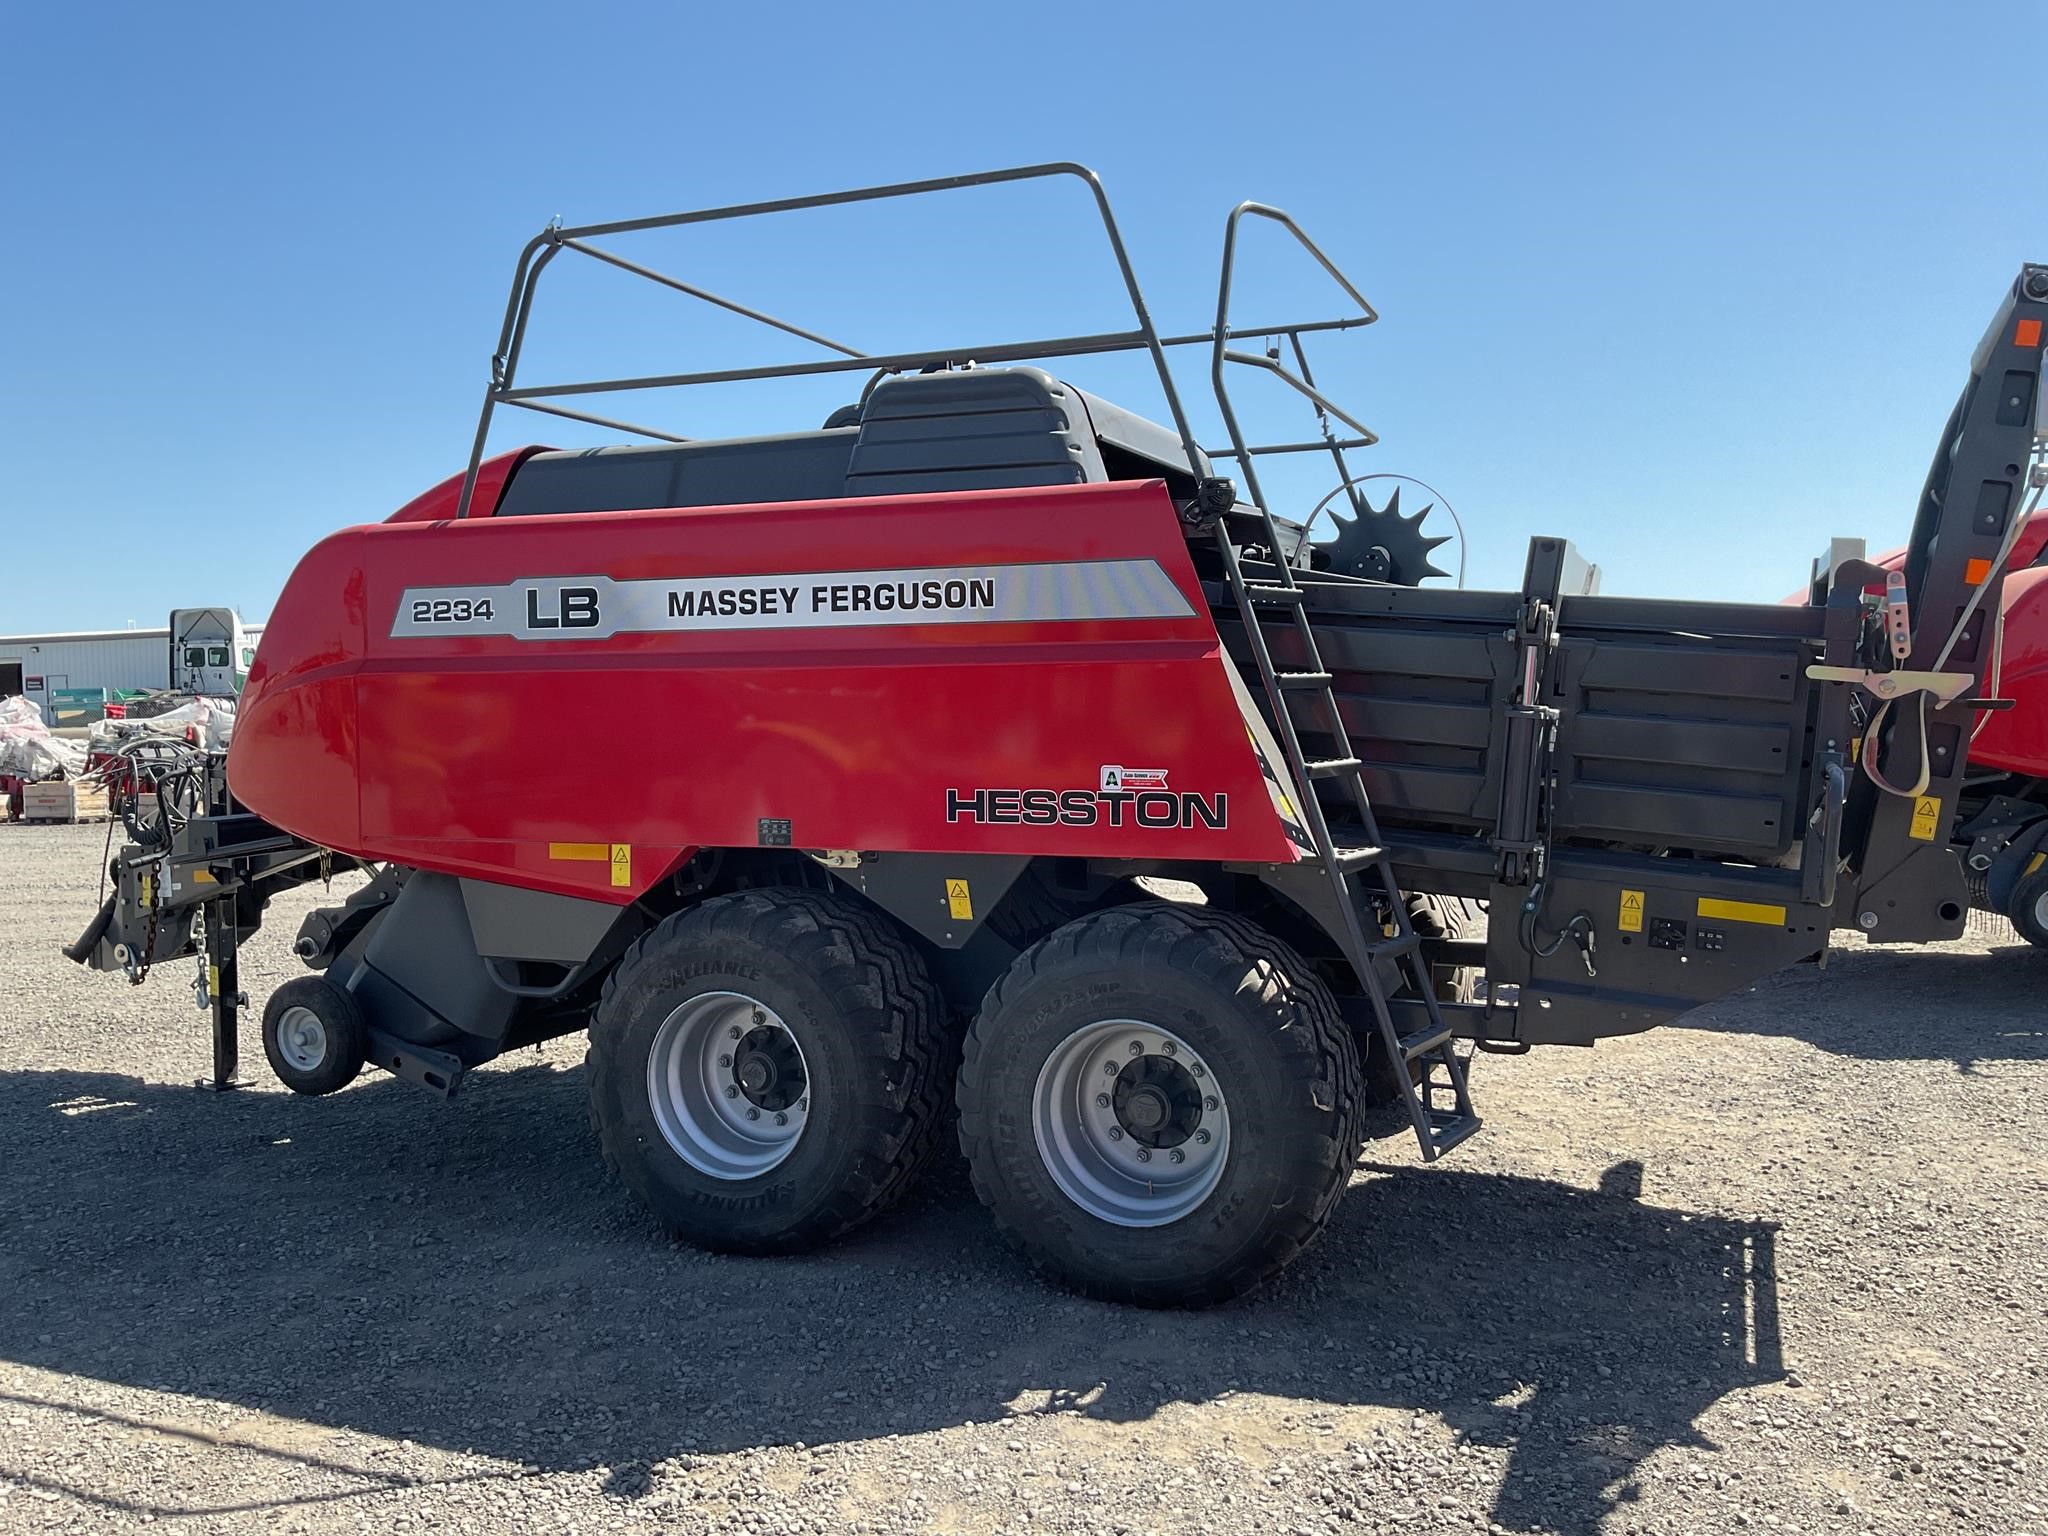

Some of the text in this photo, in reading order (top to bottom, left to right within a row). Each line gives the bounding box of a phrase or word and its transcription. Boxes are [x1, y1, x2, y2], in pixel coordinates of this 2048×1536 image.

[412, 598, 495, 623] 2234
[526, 586, 601, 630] LB
[667, 578, 996, 618] MASSEY FERGUSON
[946, 788, 1228, 830] HESSTON
[672, 959, 763, 990] ALLIANCE
